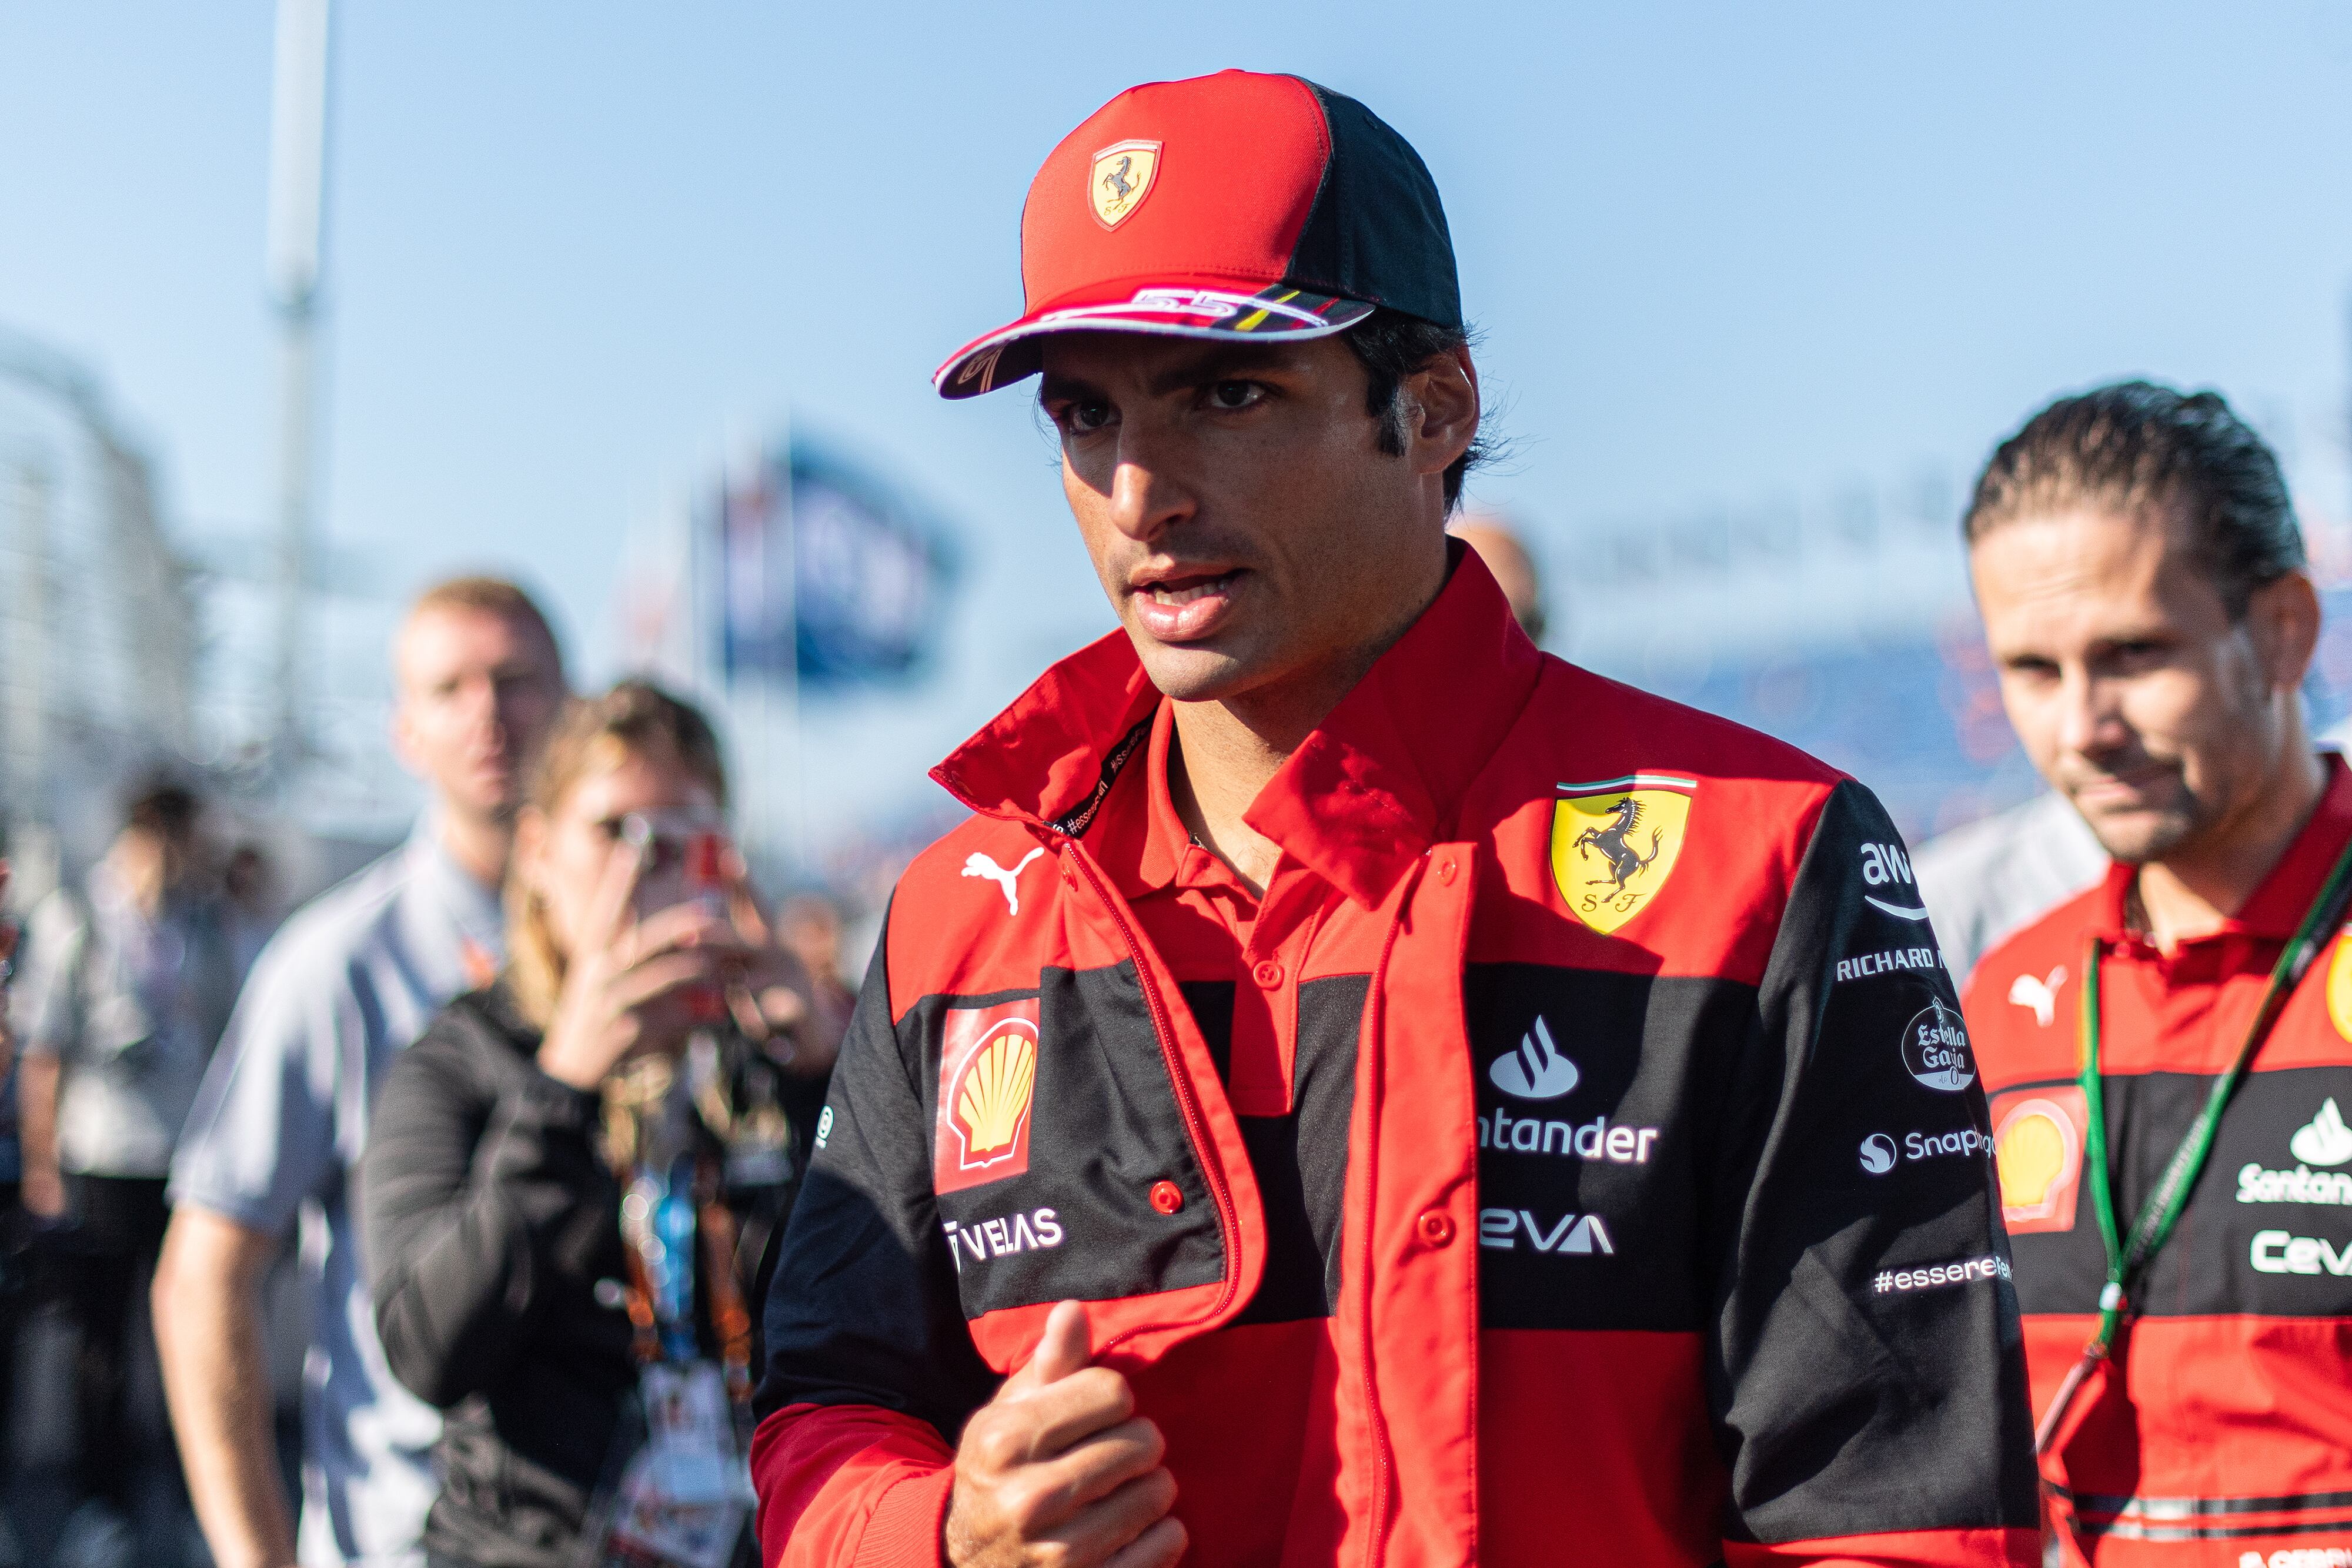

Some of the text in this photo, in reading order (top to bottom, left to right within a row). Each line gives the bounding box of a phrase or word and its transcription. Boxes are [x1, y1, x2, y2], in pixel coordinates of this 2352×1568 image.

[1131, 289, 1238, 317] 55
[1581, 894, 1598, 912] S
[1837, 948, 1935, 982] RICHARD
[960, 1208, 1062, 1261] VELAS
